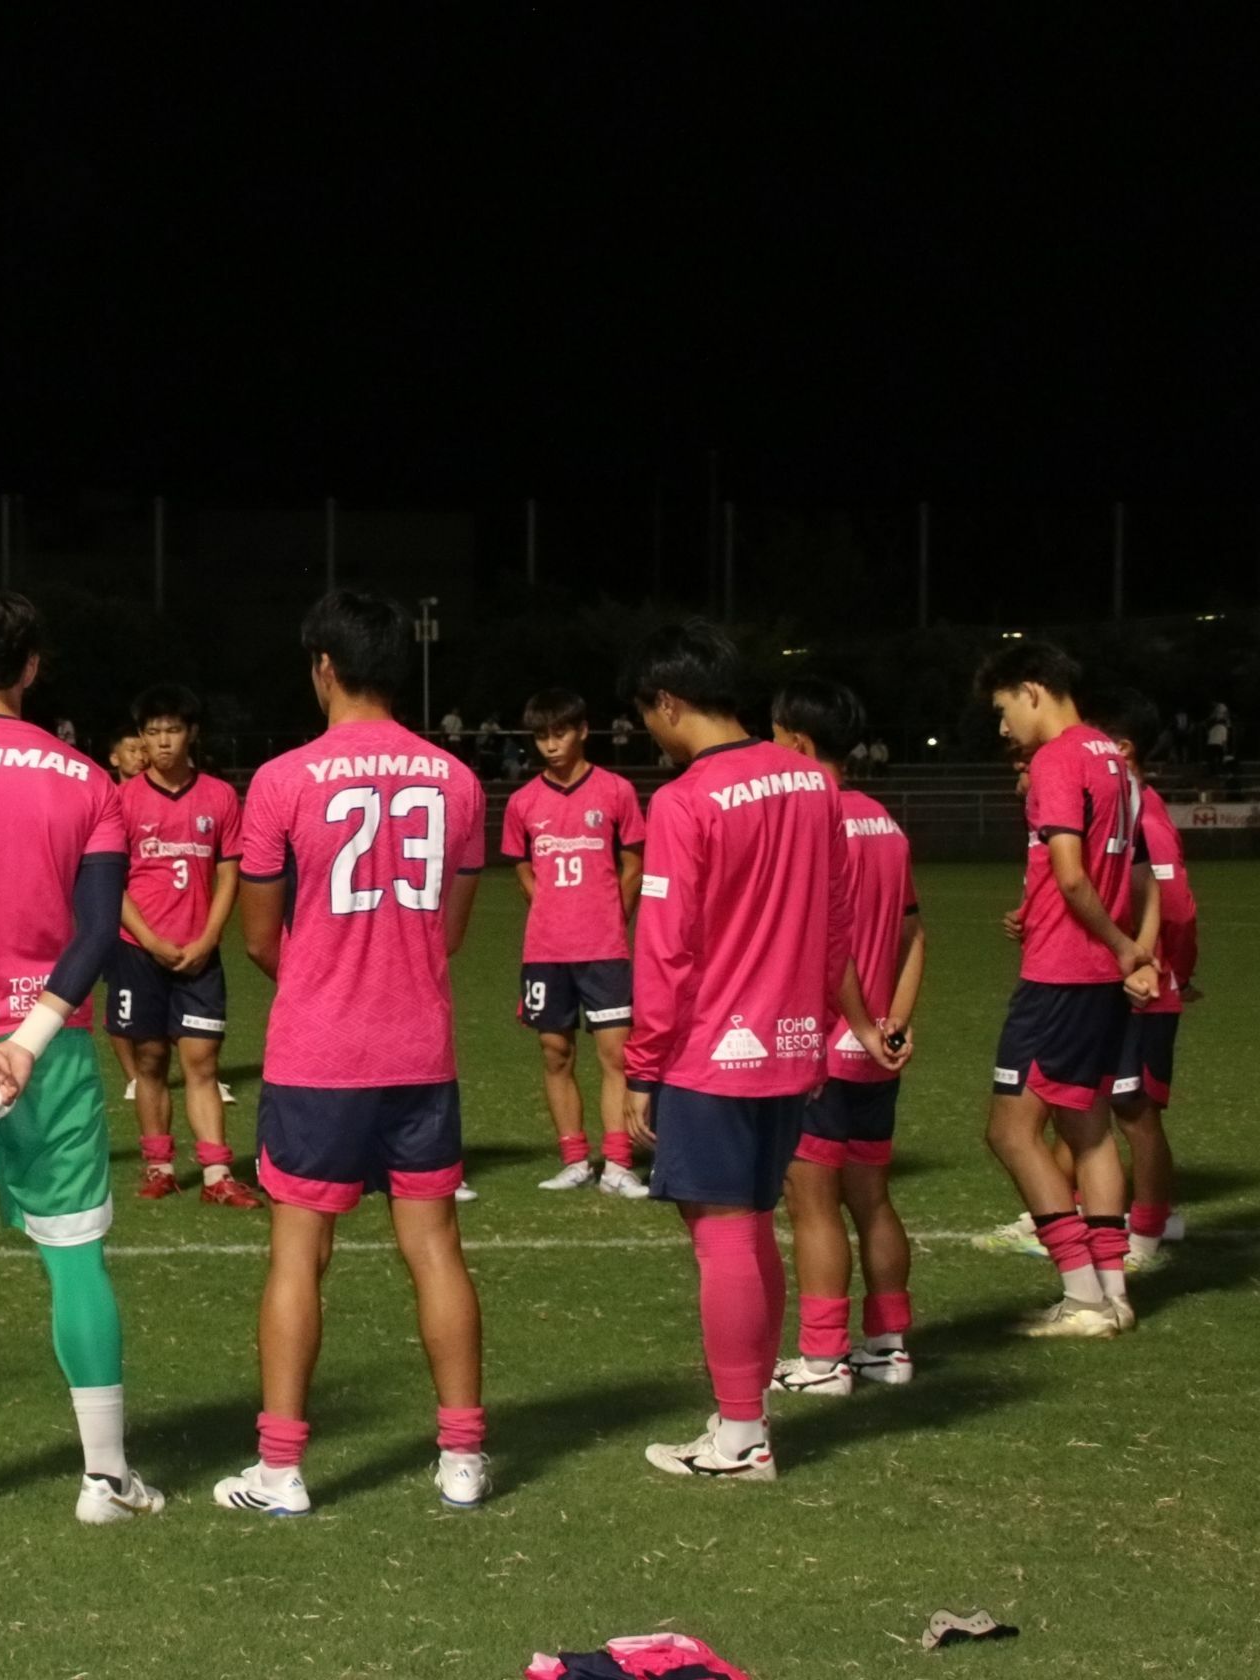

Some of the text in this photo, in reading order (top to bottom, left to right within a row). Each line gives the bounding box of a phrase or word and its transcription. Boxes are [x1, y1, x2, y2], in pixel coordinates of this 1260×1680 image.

[1082, 740, 1120, 756] YAN
[306, 754, 449, 783] YANMAR
[709, 771, 826, 811] YANMAR
[843, 816, 906, 838] ANMA
[326, 785, 446, 915] 23
[172, 859, 188, 889] 3
[554, 856, 582, 887] 19
[9, 974, 50, 993] TOH
[525, 980, 546, 1011] 19
[9, 994, 39, 1011] RES
[118, 989, 132, 1019] 3
[776, 1016, 816, 1034] TOHO
